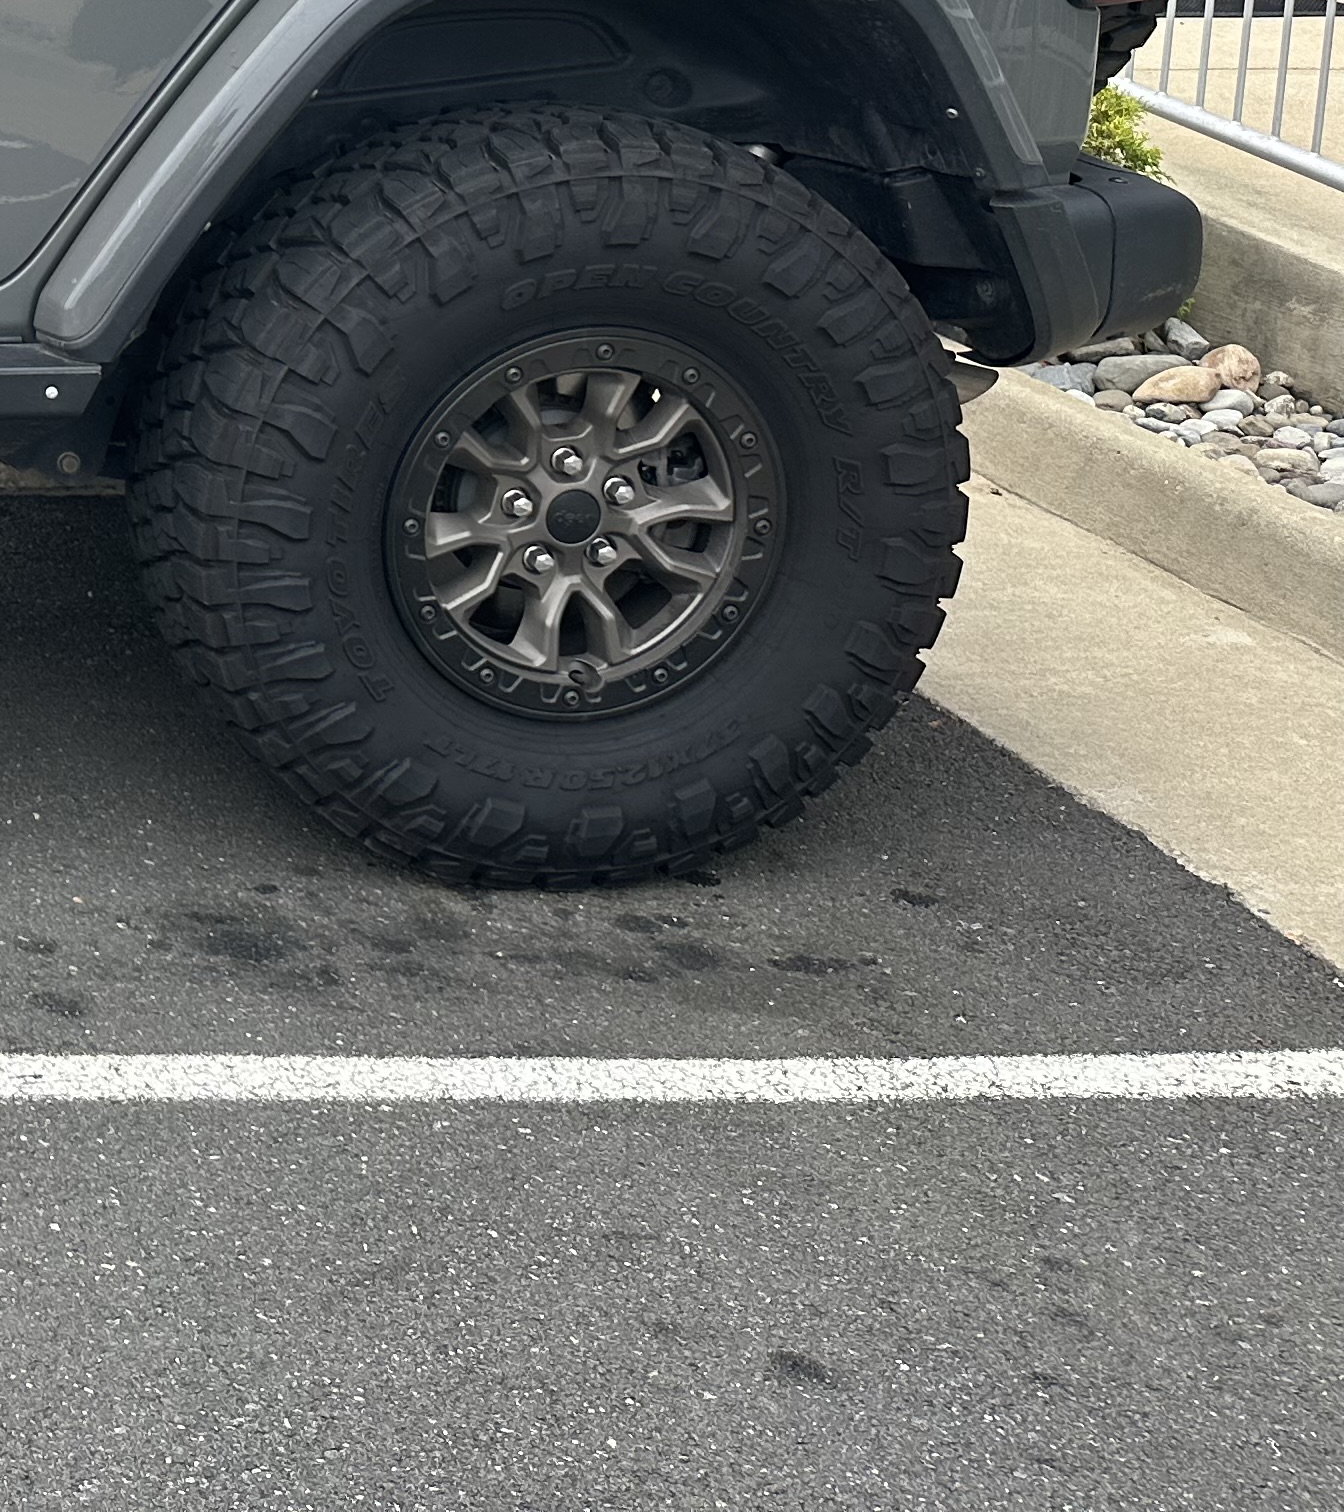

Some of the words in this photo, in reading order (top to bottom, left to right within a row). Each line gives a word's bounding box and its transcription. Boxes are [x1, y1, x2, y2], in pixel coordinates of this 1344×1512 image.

[501, 262, 659, 311] OPEN
[663, 271, 854, 437] COUNTRY
[325, 557, 396, 703] TOYO
